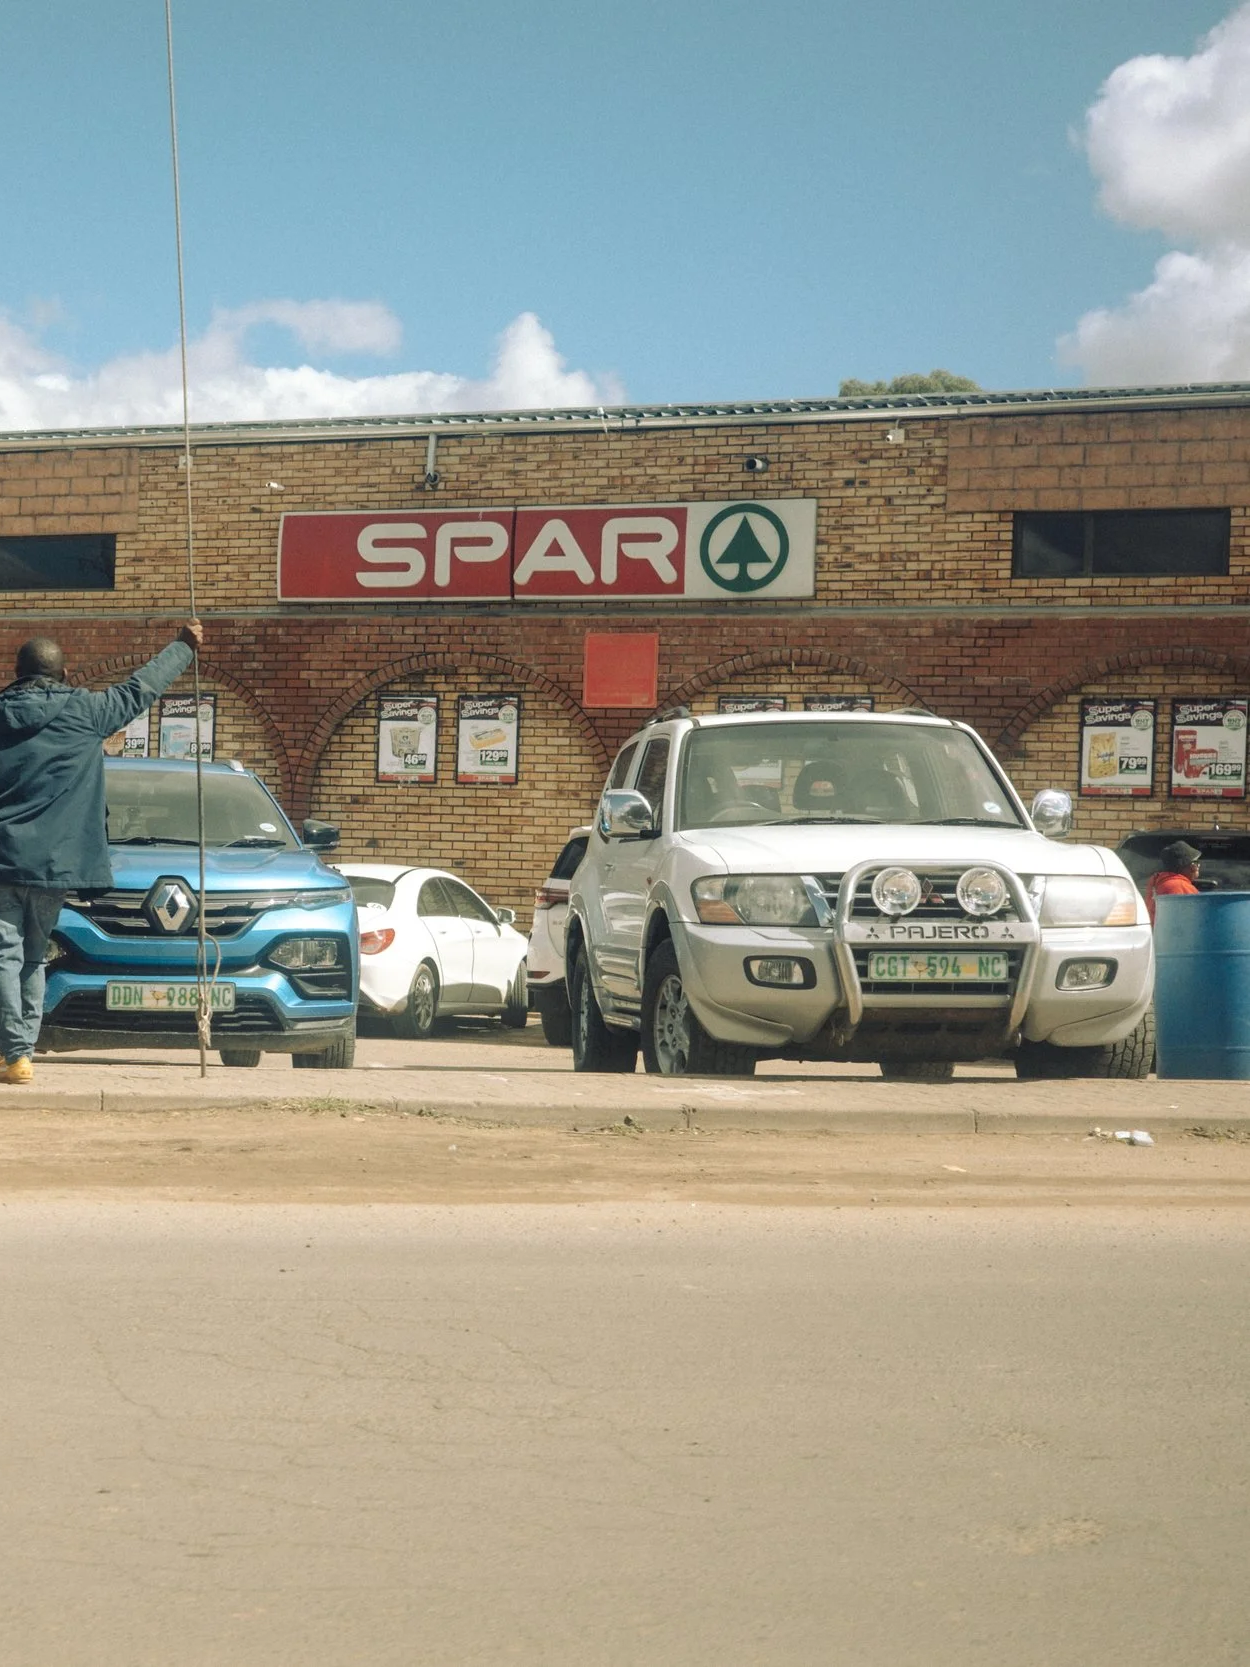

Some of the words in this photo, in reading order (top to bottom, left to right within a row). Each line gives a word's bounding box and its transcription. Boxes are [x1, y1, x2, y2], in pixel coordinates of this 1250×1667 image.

[356, 517, 679, 588] SPAR
[165, 699, 193, 709] Super
[384, 701, 414, 711] Super
[464, 700, 495, 711] Super
[725, 702, 759, 713] Super
[811, 702, 845, 712] Super
[1088, 704, 1126, 715] Super
[1179, 704, 1217, 715] Super
[381, 708, 418, 719] Savings
[461, 708, 499, 718] Savings
[1084, 712, 1131, 724] Savings
[1175, 711, 1223, 723] Savings
[890, 926, 989, 939] PAJERO
[875, 956, 910, 977] CGT
[926, 956, 961, 977] 594
[978, 956, 1001, 977] NC
[111, 985, 143, 1005] DDN
[166, 987, 198, 1006] 988
[211, 987, 231, 1007] NC
